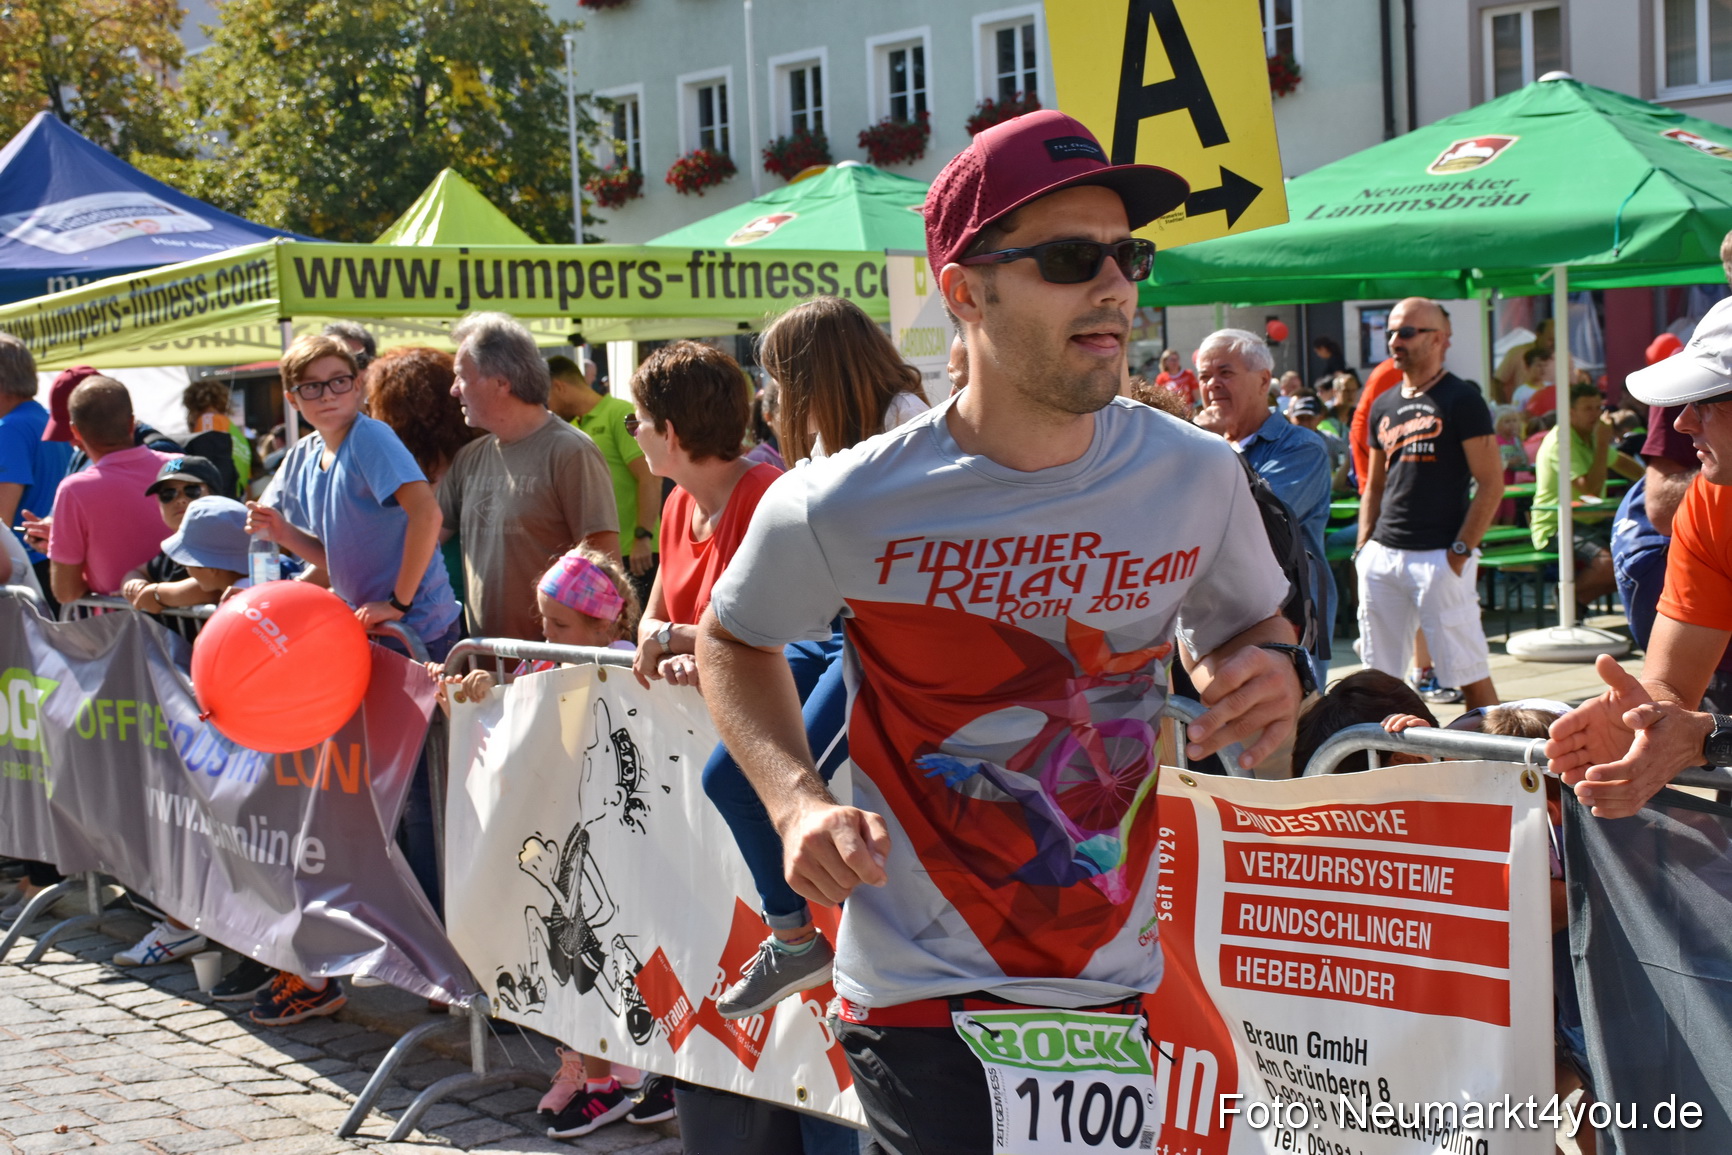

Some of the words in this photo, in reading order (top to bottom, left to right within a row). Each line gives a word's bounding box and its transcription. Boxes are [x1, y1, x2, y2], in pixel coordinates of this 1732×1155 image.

[1111, 0, 1230, 165] A
[1304, 190, 1531, 221] Lammsbräu
[1355, 177, 1519, 200] Neumarkter
[875, 532, 1102, 585] FINISHER
[926, 563, 1089, 613] RELAY
[1098, 546, 1201, 599] TEAM
[995, 595, 1073, 626] ROTH
[1086, 591, 1150, 614] 2016
[1231, 806, 1408, 836] BINDESTRICKE
[1158, 827, 1175, 874] 1929
[1239, 851, 1455, 896] VERZURRSYSTEME
[1157, 884, 1173, 921] Seit
[1239, 903, 1432, 951] RUNDSCHLINGEN
[1236, 955, 1395, 1001] HEBEBÄNDER
[655, 995, 689, 1039] Braun
[984, 1021, 1146, 1067] BOCK
[1243, 1020, 1298, 1056] Braun
[1306, 1031, 1368, 1066] GmbH
[1256, 1051, 1283, 1079] Am
[1284, 1059, 1372, 1107] Grünberg
[1378, 1077, 1391, 1103] 8
[1015, 1077, 1144, 1149] 1100
